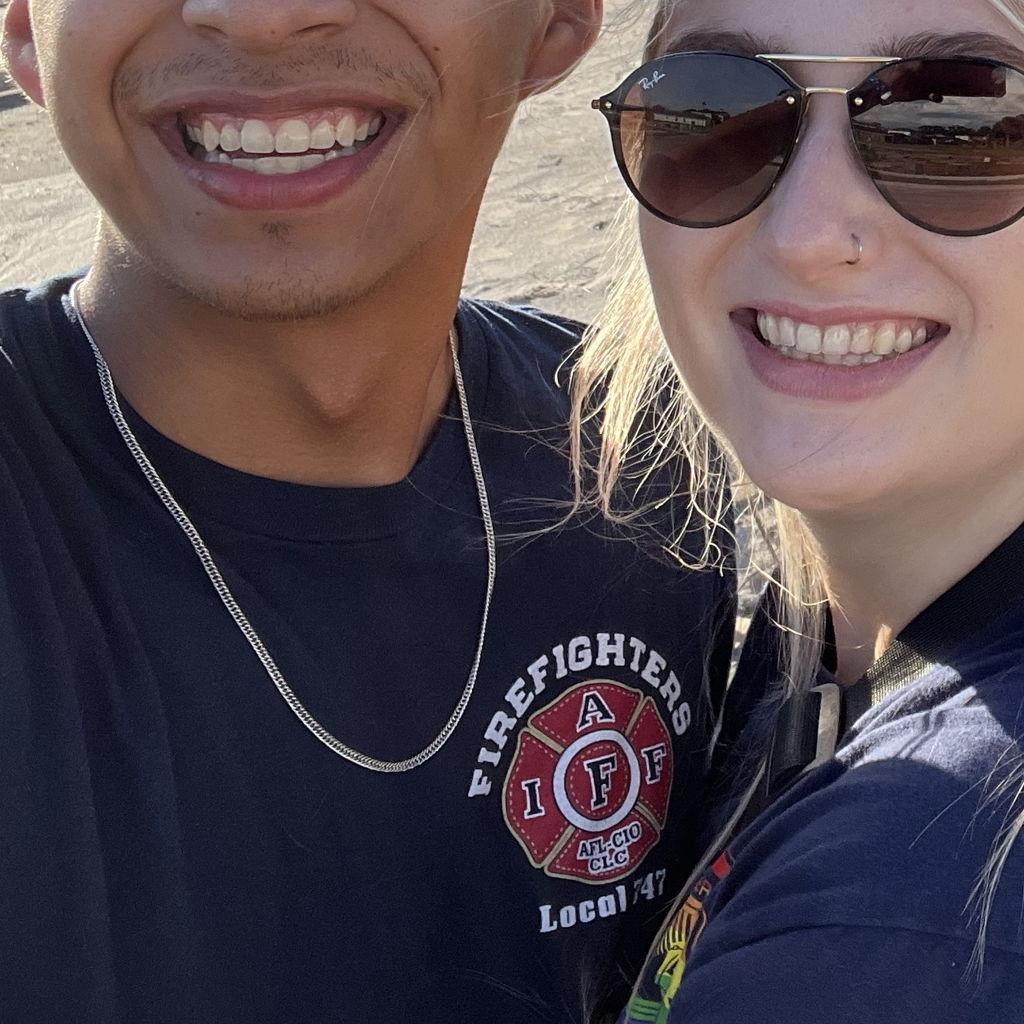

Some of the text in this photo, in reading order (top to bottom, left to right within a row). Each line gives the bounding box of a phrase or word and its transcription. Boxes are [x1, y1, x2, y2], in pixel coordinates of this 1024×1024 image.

[467, 632, 691, 798] FIREFIGHTERS
[576, 690, 615, 732] A
[583, 753, 618, 810] F
[641, 743, 667, 784] F
[576, 822, 642, 860] AFL-CIO
[589, 850, 629, 873] CLC
[539, 869, 667, 933] Local 747
